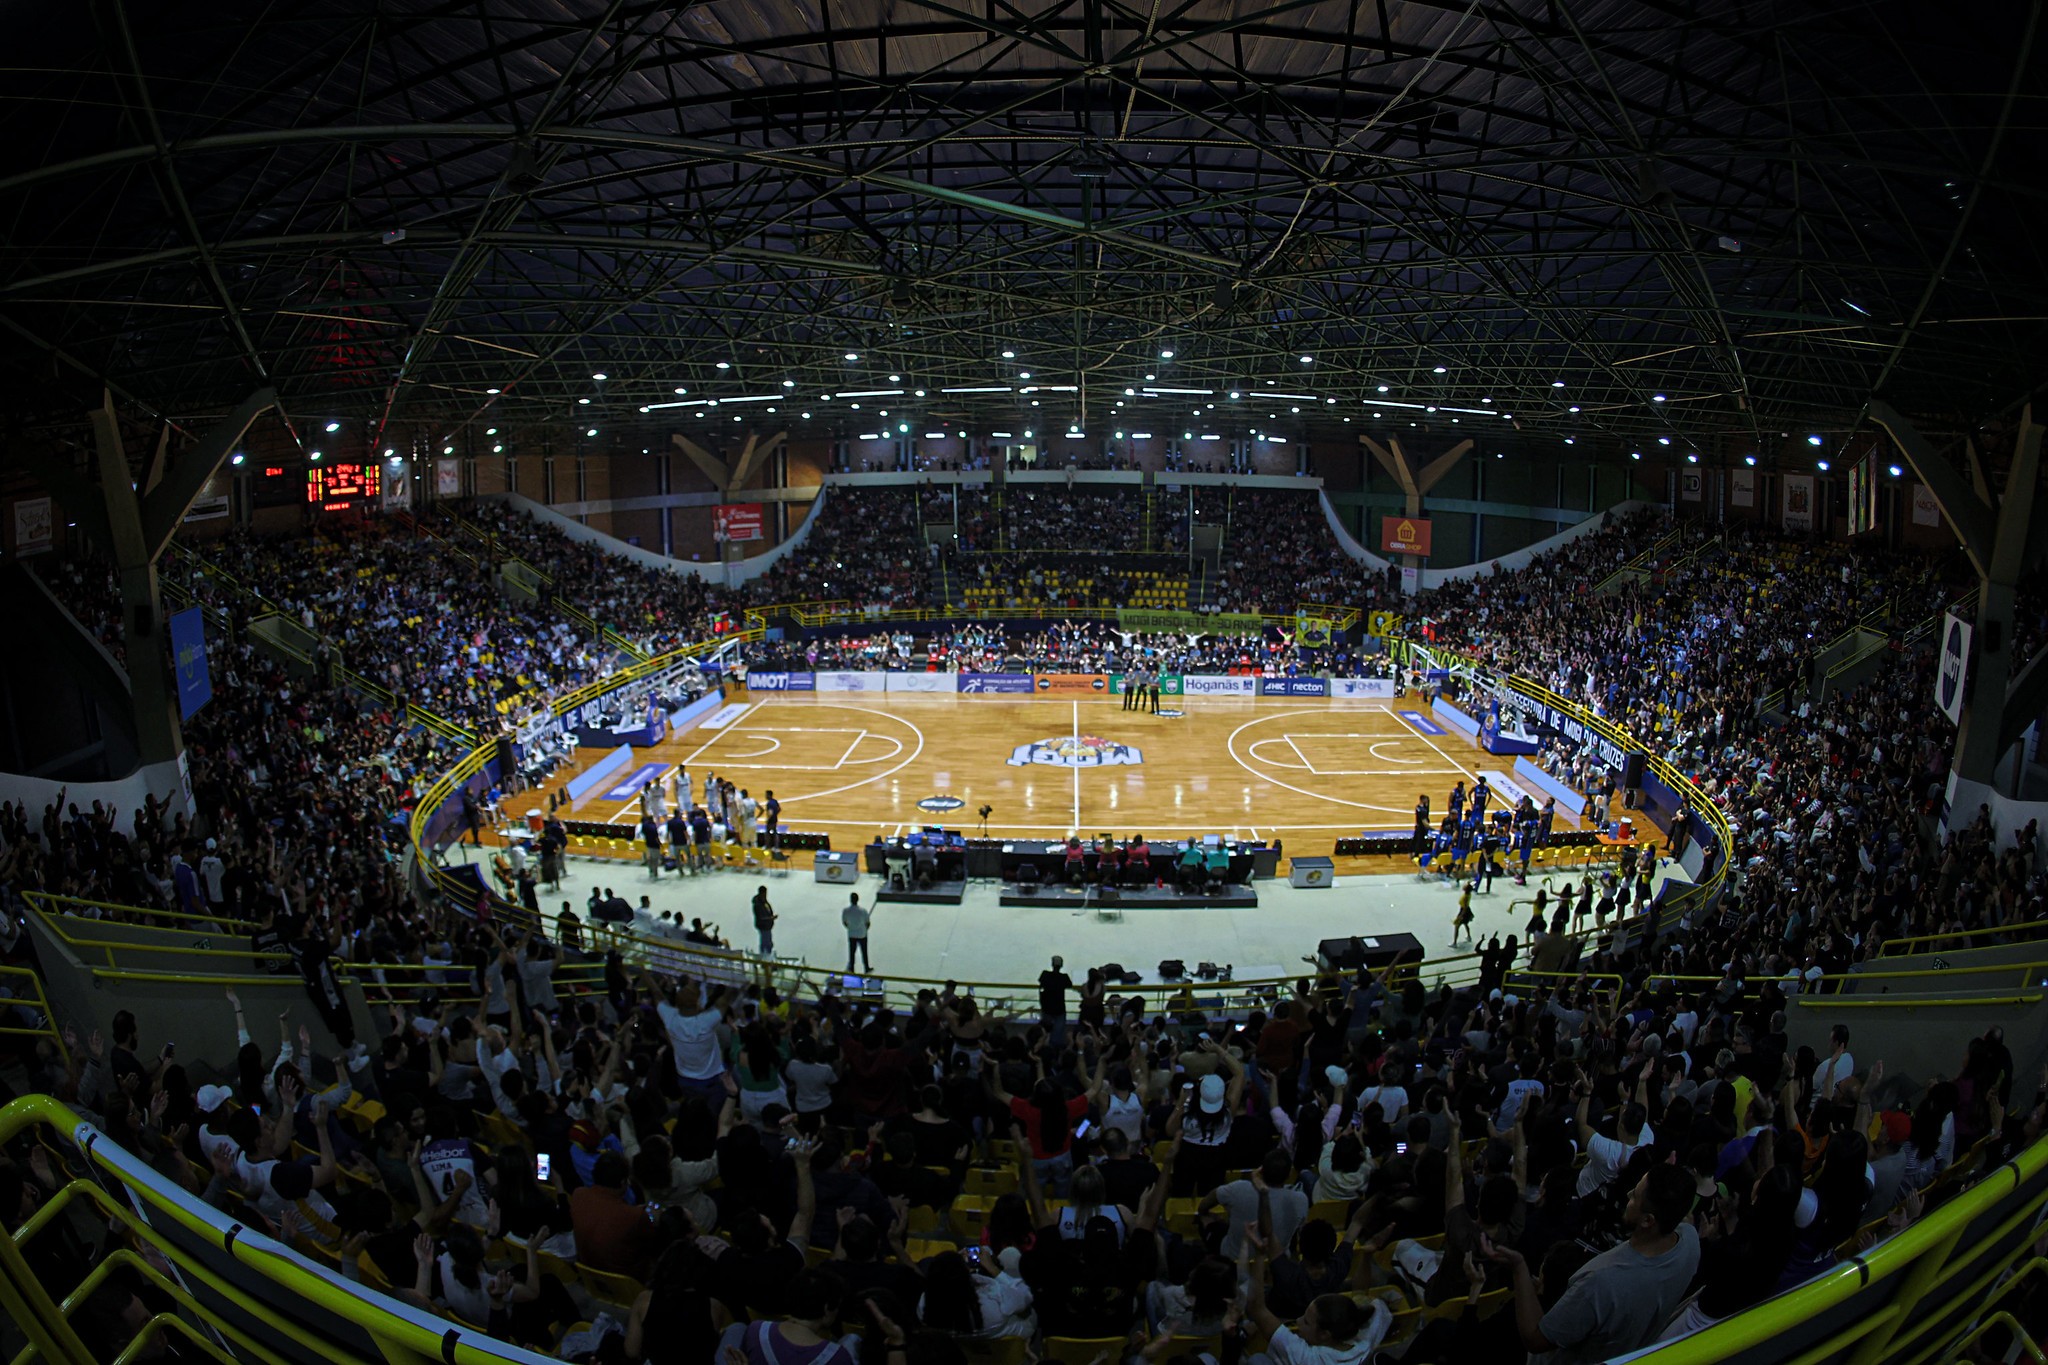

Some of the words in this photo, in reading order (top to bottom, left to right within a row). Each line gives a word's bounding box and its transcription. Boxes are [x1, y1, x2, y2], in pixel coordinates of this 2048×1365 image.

[1124, 615, 1149, 626] MOGI
[1152, 615, 1209, 628] BASQUETE
[1219, 618, 1231, 629] 30
[1233, 619, 1261, 631] ANOS
[751, 674, 787, 689] IMOT
[1186, 679, 1239, 691] Höganäs
[1292, 683, 1323, 692] necton
[1550, 710, 1562, 731] DE
[1564, 717, 1582, 743] MOGI
[1599, 738, 1625, 772] CRUZES
[431, 1162, 453, 1172] LIMA
